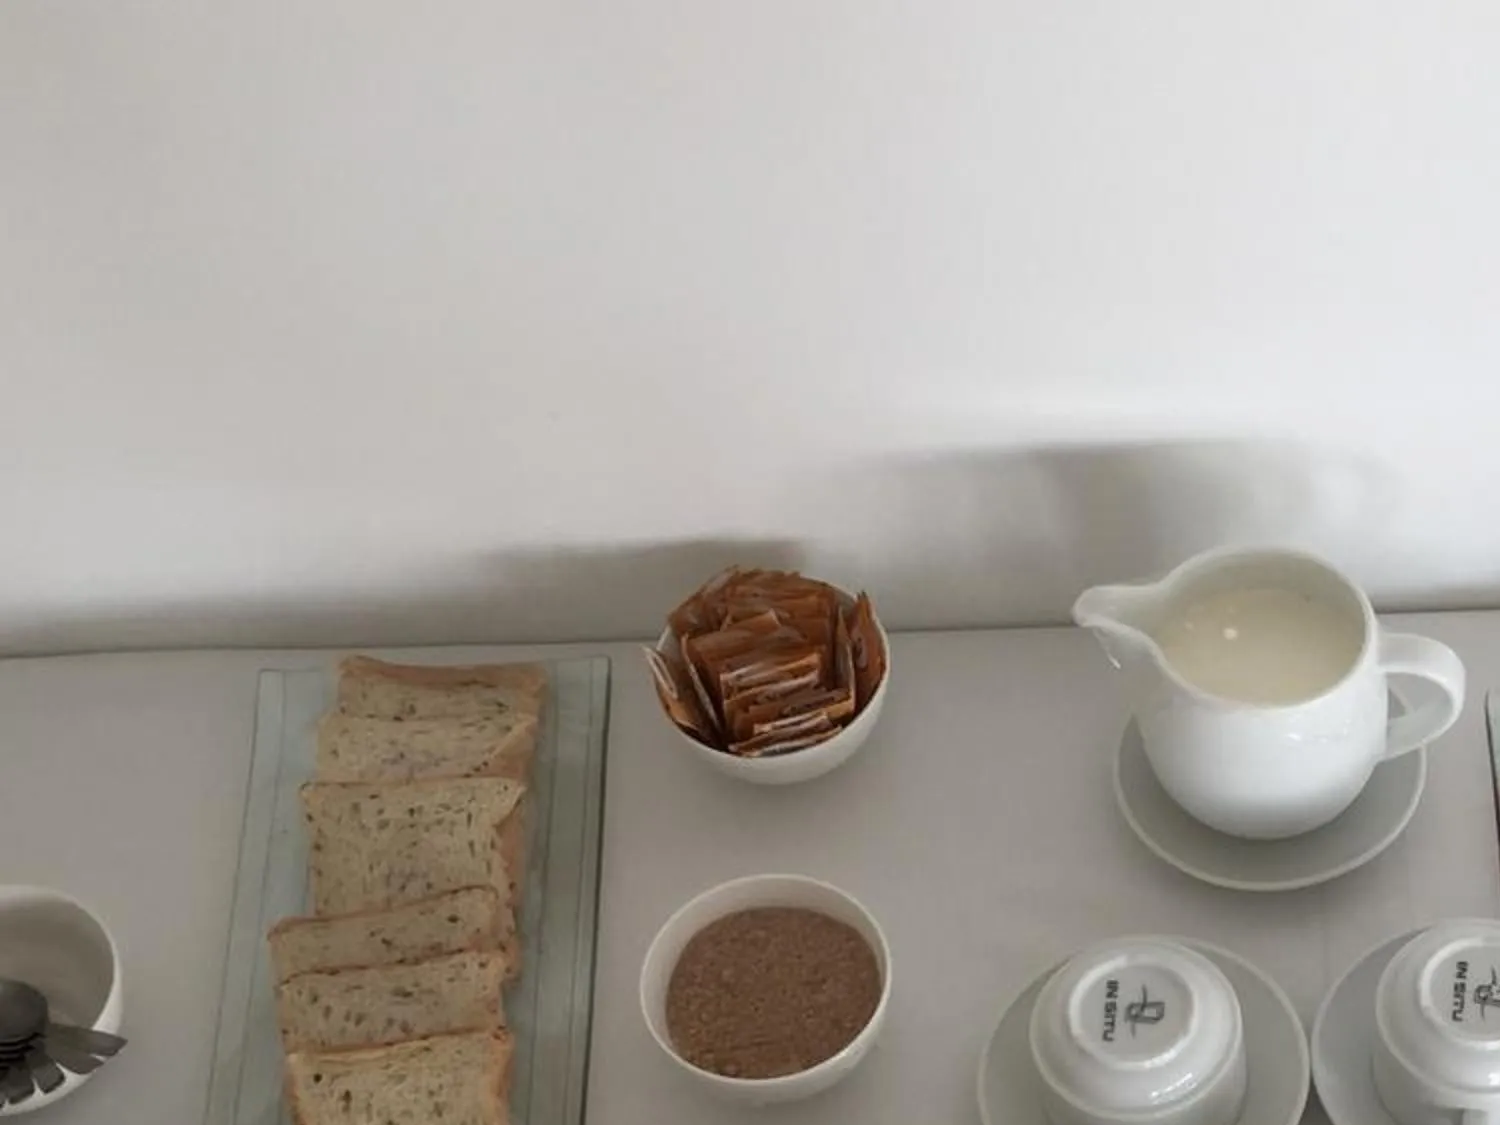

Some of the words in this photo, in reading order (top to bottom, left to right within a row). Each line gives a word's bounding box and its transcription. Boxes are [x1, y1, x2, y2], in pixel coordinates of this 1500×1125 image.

[1456, 961, 1469, 980] IN
[1106, 979, 1120, 999] IN
[1452, 982, 1466, 1022] SITU
[1102, 1002, 1118, 1042] SITU
